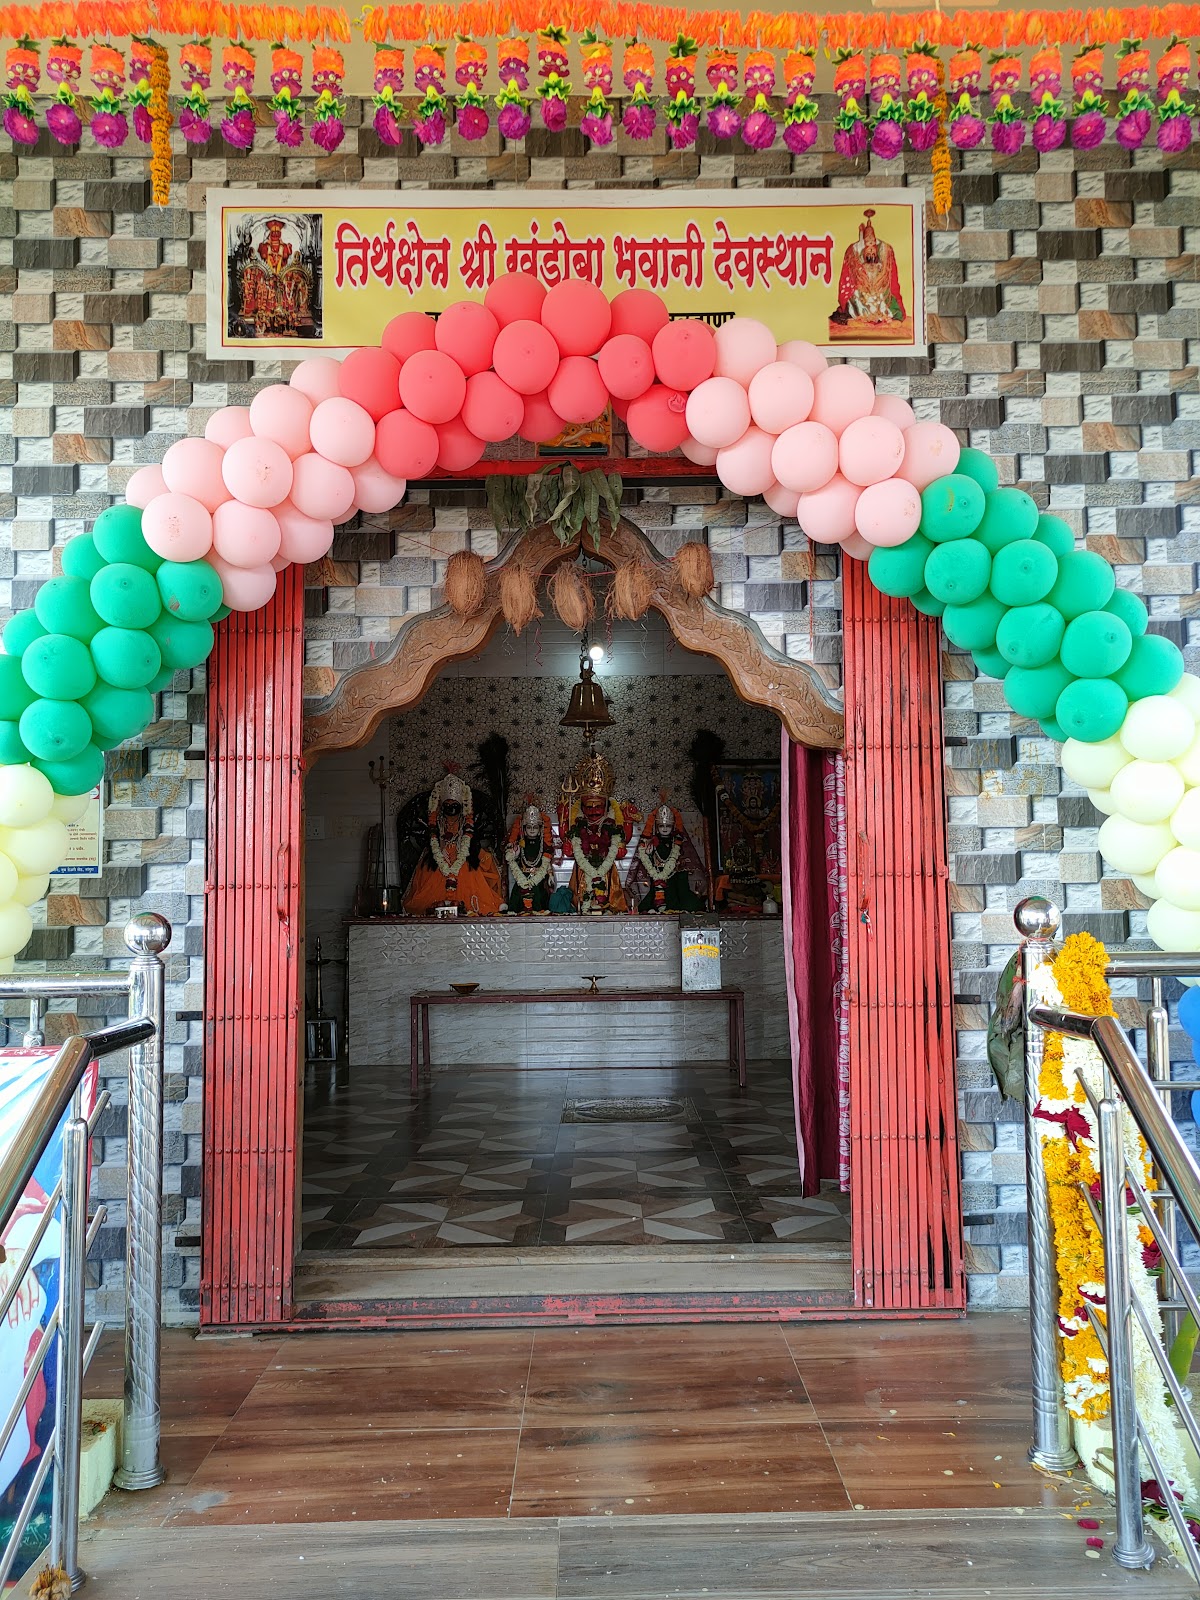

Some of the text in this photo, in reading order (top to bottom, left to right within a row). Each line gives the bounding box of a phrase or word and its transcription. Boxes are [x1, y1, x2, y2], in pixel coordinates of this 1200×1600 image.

[334, 220, 834, 295] तिर्थक्षेत्र श्री खंडोबा भवानी देवस्थान
